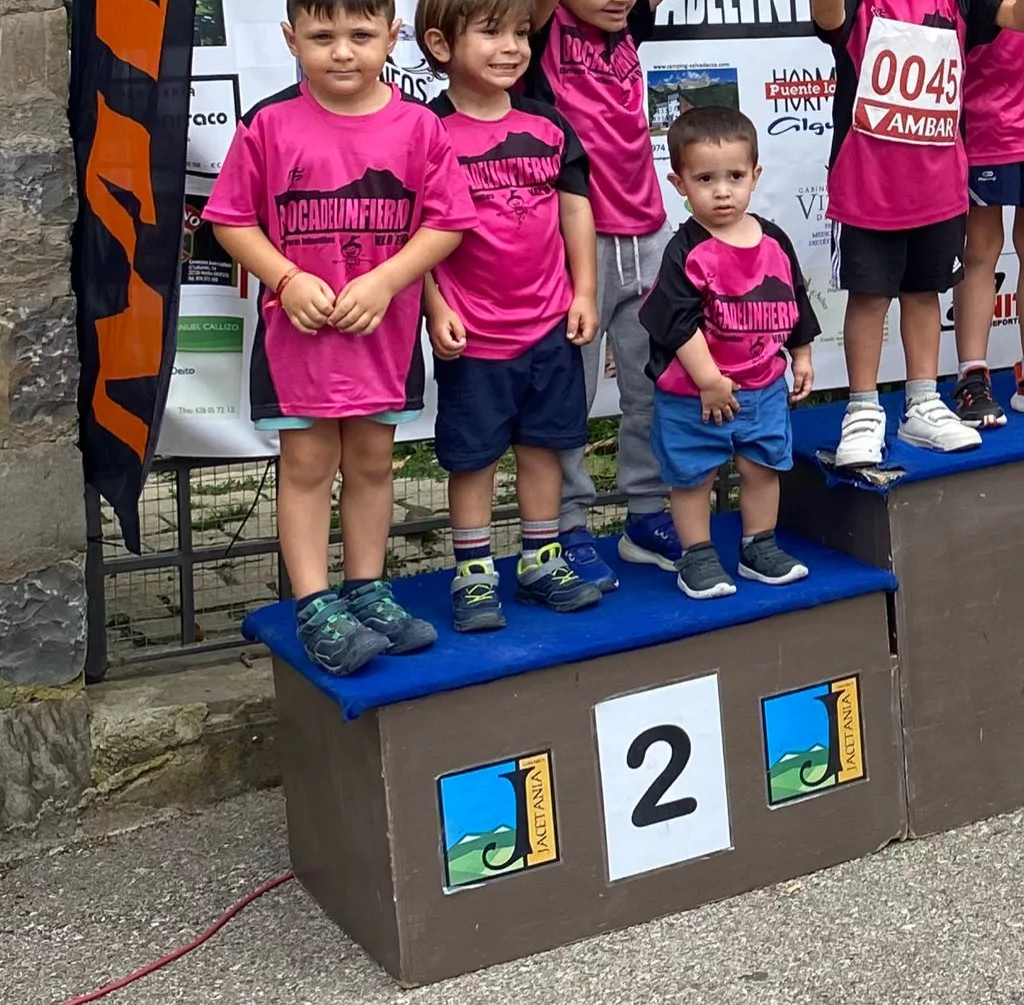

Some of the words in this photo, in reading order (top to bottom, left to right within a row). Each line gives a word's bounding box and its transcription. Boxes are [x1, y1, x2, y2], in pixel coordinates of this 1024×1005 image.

[769, 82, 821, 97] Puente
[871, 48, 959, 106] 0045
[887, 114, 955, 139] AMBAR
[203, 322, 240, 332] CALLIZO
[840, 695, 858, 773] JACETANIA
[626, 723, 698, 828] 2
[530, 769, 550, 855] JACETANIA
